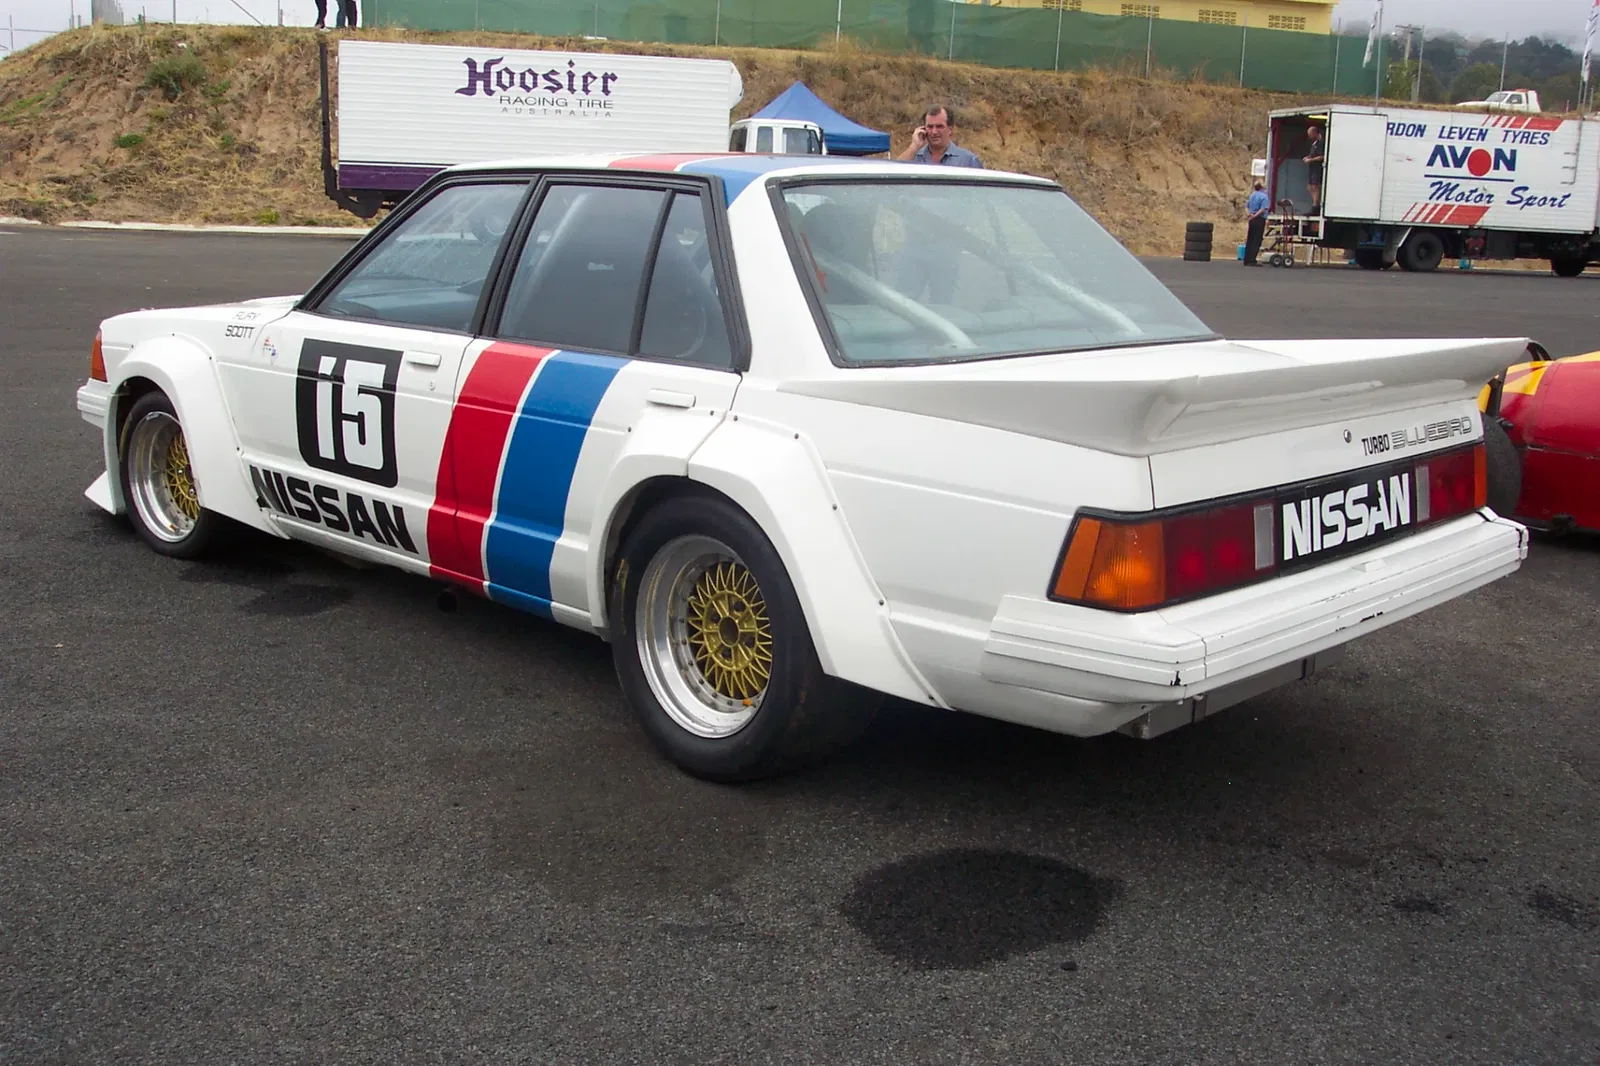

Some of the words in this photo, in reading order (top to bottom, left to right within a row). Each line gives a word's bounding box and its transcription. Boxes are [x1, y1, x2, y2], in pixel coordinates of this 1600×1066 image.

[454, 56, 618, 97] Hoosier
[499, 95, 568, 108] RACING
[577, 98, 613, 109] TIRE
[501, 106, 612, 117] AUSTRALIA
[1386, 121, 1427, 138] RDON
[1437, 125, 1488, 142] LEVEN
[1502, 129, 1550, 145] TYRES
[1426, 144, 1517, 177] AVON
[1428, 181, 1495, 204] Motor
[1506, 186, 1571, 210] Sport
[225, 324, 255, 338] SCOTT
[316, 355, 387, 471] 15
[1361, 433, 1391, 456] TURBO
[1391, 416, 1472, 450] BLUEBIRD
[249, 464, 420, 555] NISSAN
[1282, 472, 1411, 561] NISSAN
